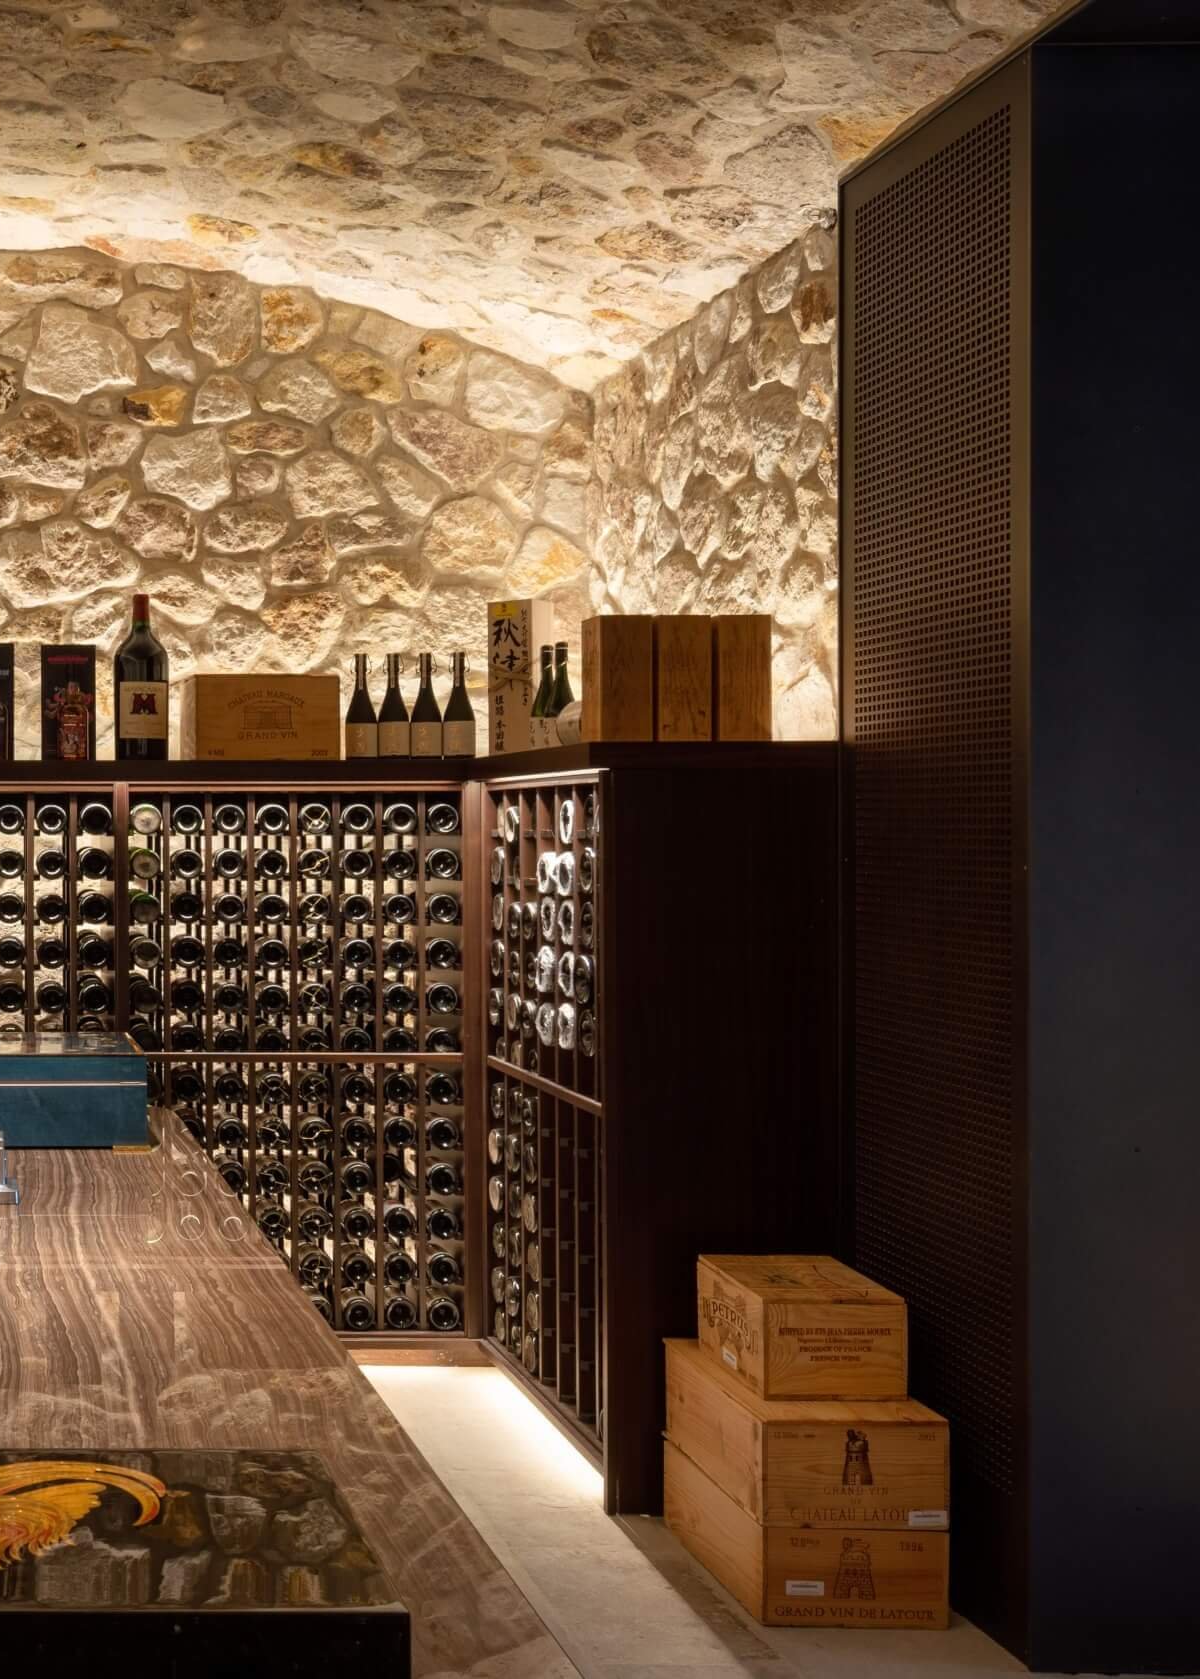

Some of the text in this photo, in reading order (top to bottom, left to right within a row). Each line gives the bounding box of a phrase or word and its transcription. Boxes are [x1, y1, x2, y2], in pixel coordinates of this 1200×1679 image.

[130, 693, 159, 715] M
[238, 730, 299, 740] GRAND VIN
[711, 1301, 750, 1337] PETRUS
[824, 1487, 888, 1496] GRAND VIN
[775, 1606, 936, 1621] GRAND VIN DE LATOUR
